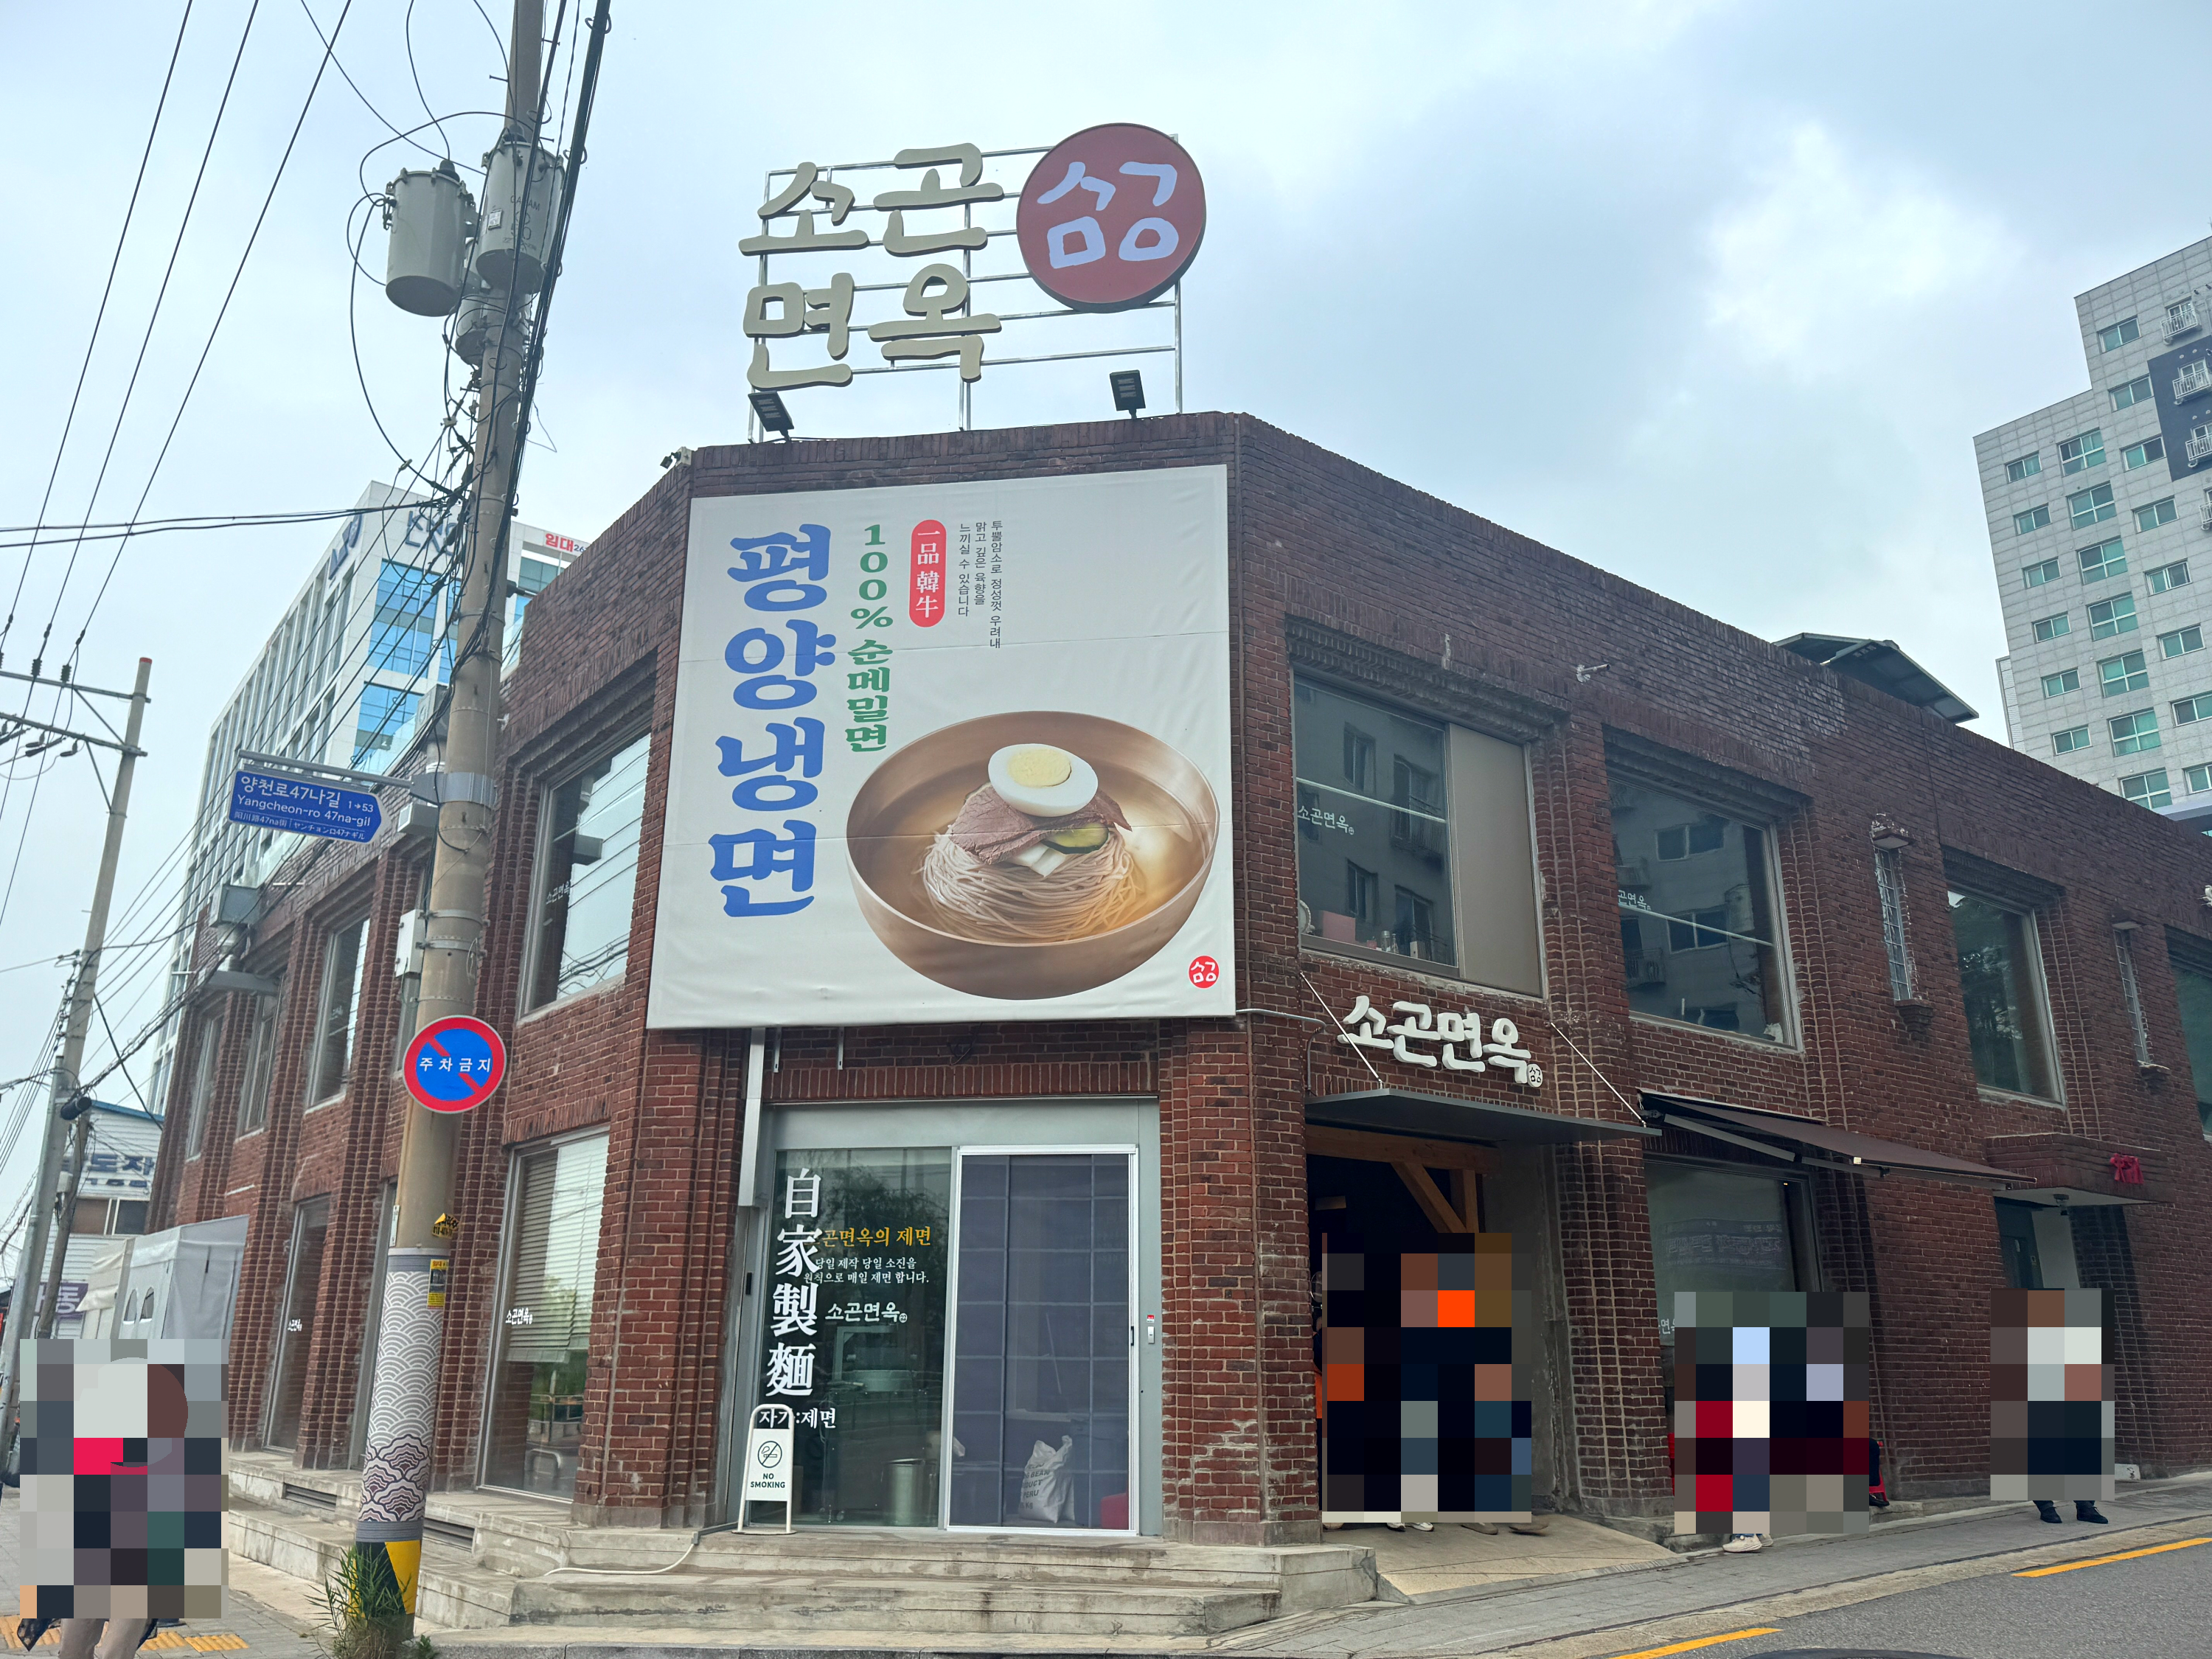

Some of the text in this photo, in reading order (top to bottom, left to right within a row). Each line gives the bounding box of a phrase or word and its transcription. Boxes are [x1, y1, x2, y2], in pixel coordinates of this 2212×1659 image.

[738, 143, 1005, 257] 소곤
[742, 263, 1002, 391] 면옥
[546, 533, 574, 552] 임대
[958, 524, 970, 617] 느끼실 수 있습니다
[974, 521, 987, 605] 맑고 깊은 육향을
[990, 520, 1003, 649] 투뿔암소로 정성껏 우려내
[845, 524, 894, 753] 100% 순메밀면
[709, 524, 837, 917] 평양냉면
[241, 776, 341, 809] 양천로47나길
[237, 794, 370, 828] Yangcheon-ro 47na-gil
[1298, 806, 1349, 833] 소곤면옥
[1337, 995, 1531, 1084] 소곤면옥
[420, 1057, 491, 1073] 주차금지
[804, 1225, 931, 1248] 곤면옥의 제면
[804, 1271, 929, 1284] 원칙으로 매일 제면 합니다.
[815, 1256, 917, 1270] 당일 제작 당일 소진을
[765, 1167, 823, 1397] 自家製麵
[505, 1307, 529, 1325] 소곤면옥
[825, 1301, 900, 1323] 소곤면옥
